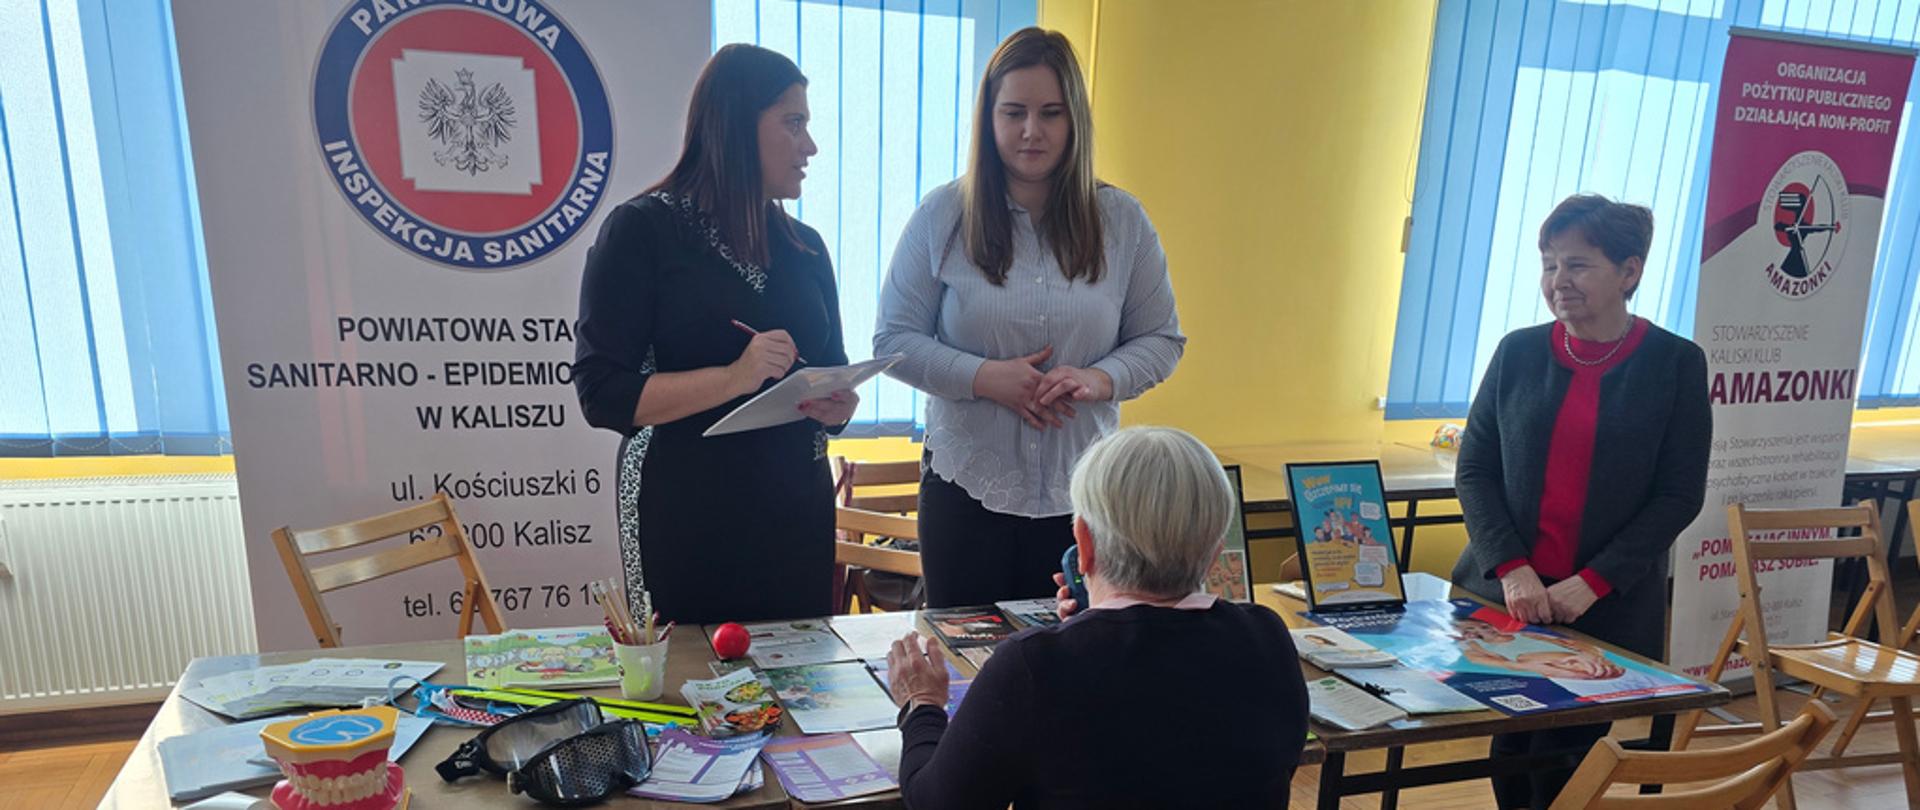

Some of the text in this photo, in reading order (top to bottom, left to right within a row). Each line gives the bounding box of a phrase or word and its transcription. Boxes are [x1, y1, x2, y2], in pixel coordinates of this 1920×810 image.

[1777, 62, 1867, 86] ORGANIZACJA
[1742, 80, 1892, 112] POŻYTKU PUBLICZNEGO
[1734, 106, 1892, 135] DZIAŁAJĄCA NON-PROFIT
[323, 140, 609, 264] INSPEKCJA SANITARNA
[1764, 261, 1833, 298] AMAZONKI
[338, 317, 579, 342] POWIATOWA STA
[1753, 347, 1782, 363] KLUB
[248, 362, 418, 389] SANITARNO
[1710, 368, 1855, 406] AMAZONKI
[417, 404, 566, 430] W KALISZU
[391, 469, 601, 502] ul. Kościuszki 6
[514, 520, 592, 547] Kalisz
[1699, 559, 1775, 581] POMAASZ
[404, 593, 441, 618] tel.
[541, 585, 571, 608] 76
